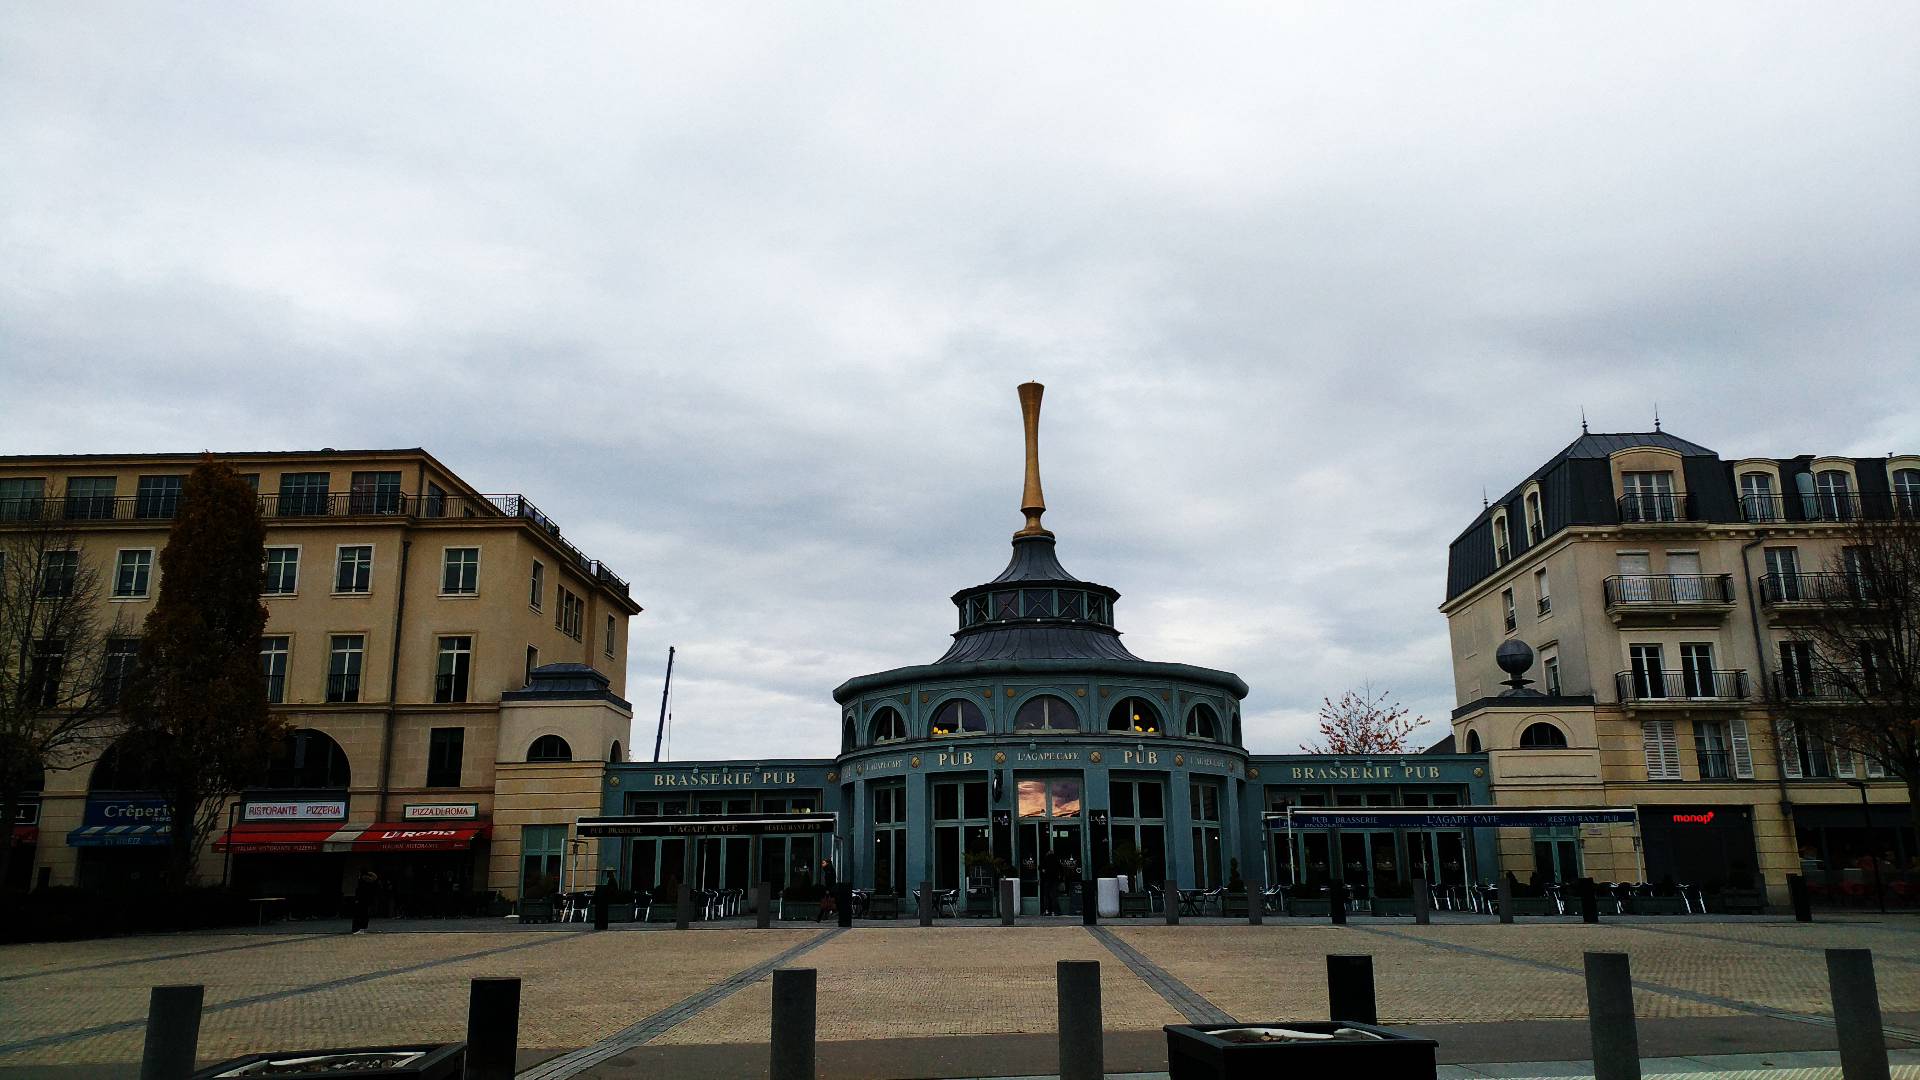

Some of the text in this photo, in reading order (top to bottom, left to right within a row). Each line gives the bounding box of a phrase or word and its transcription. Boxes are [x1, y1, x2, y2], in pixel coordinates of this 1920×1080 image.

[938, 752, 973, 767] PUB
[1124, 751, 1158, 764] PUB
[653, 771, 797, 786] BRASSERIE PUB
[1291, 766, 1441, 779] BRASSERIE PUB
[248, 805, 341, 816] RISTORANTE PIZZERIA
[412, 808, 434, 816] PIZZA
[445, 807, 469, 816] ROMA
[1312, 816, 1379, 824] PUB BRASSERIE
[1548, 815, 1600, 823] RESTAURANT
